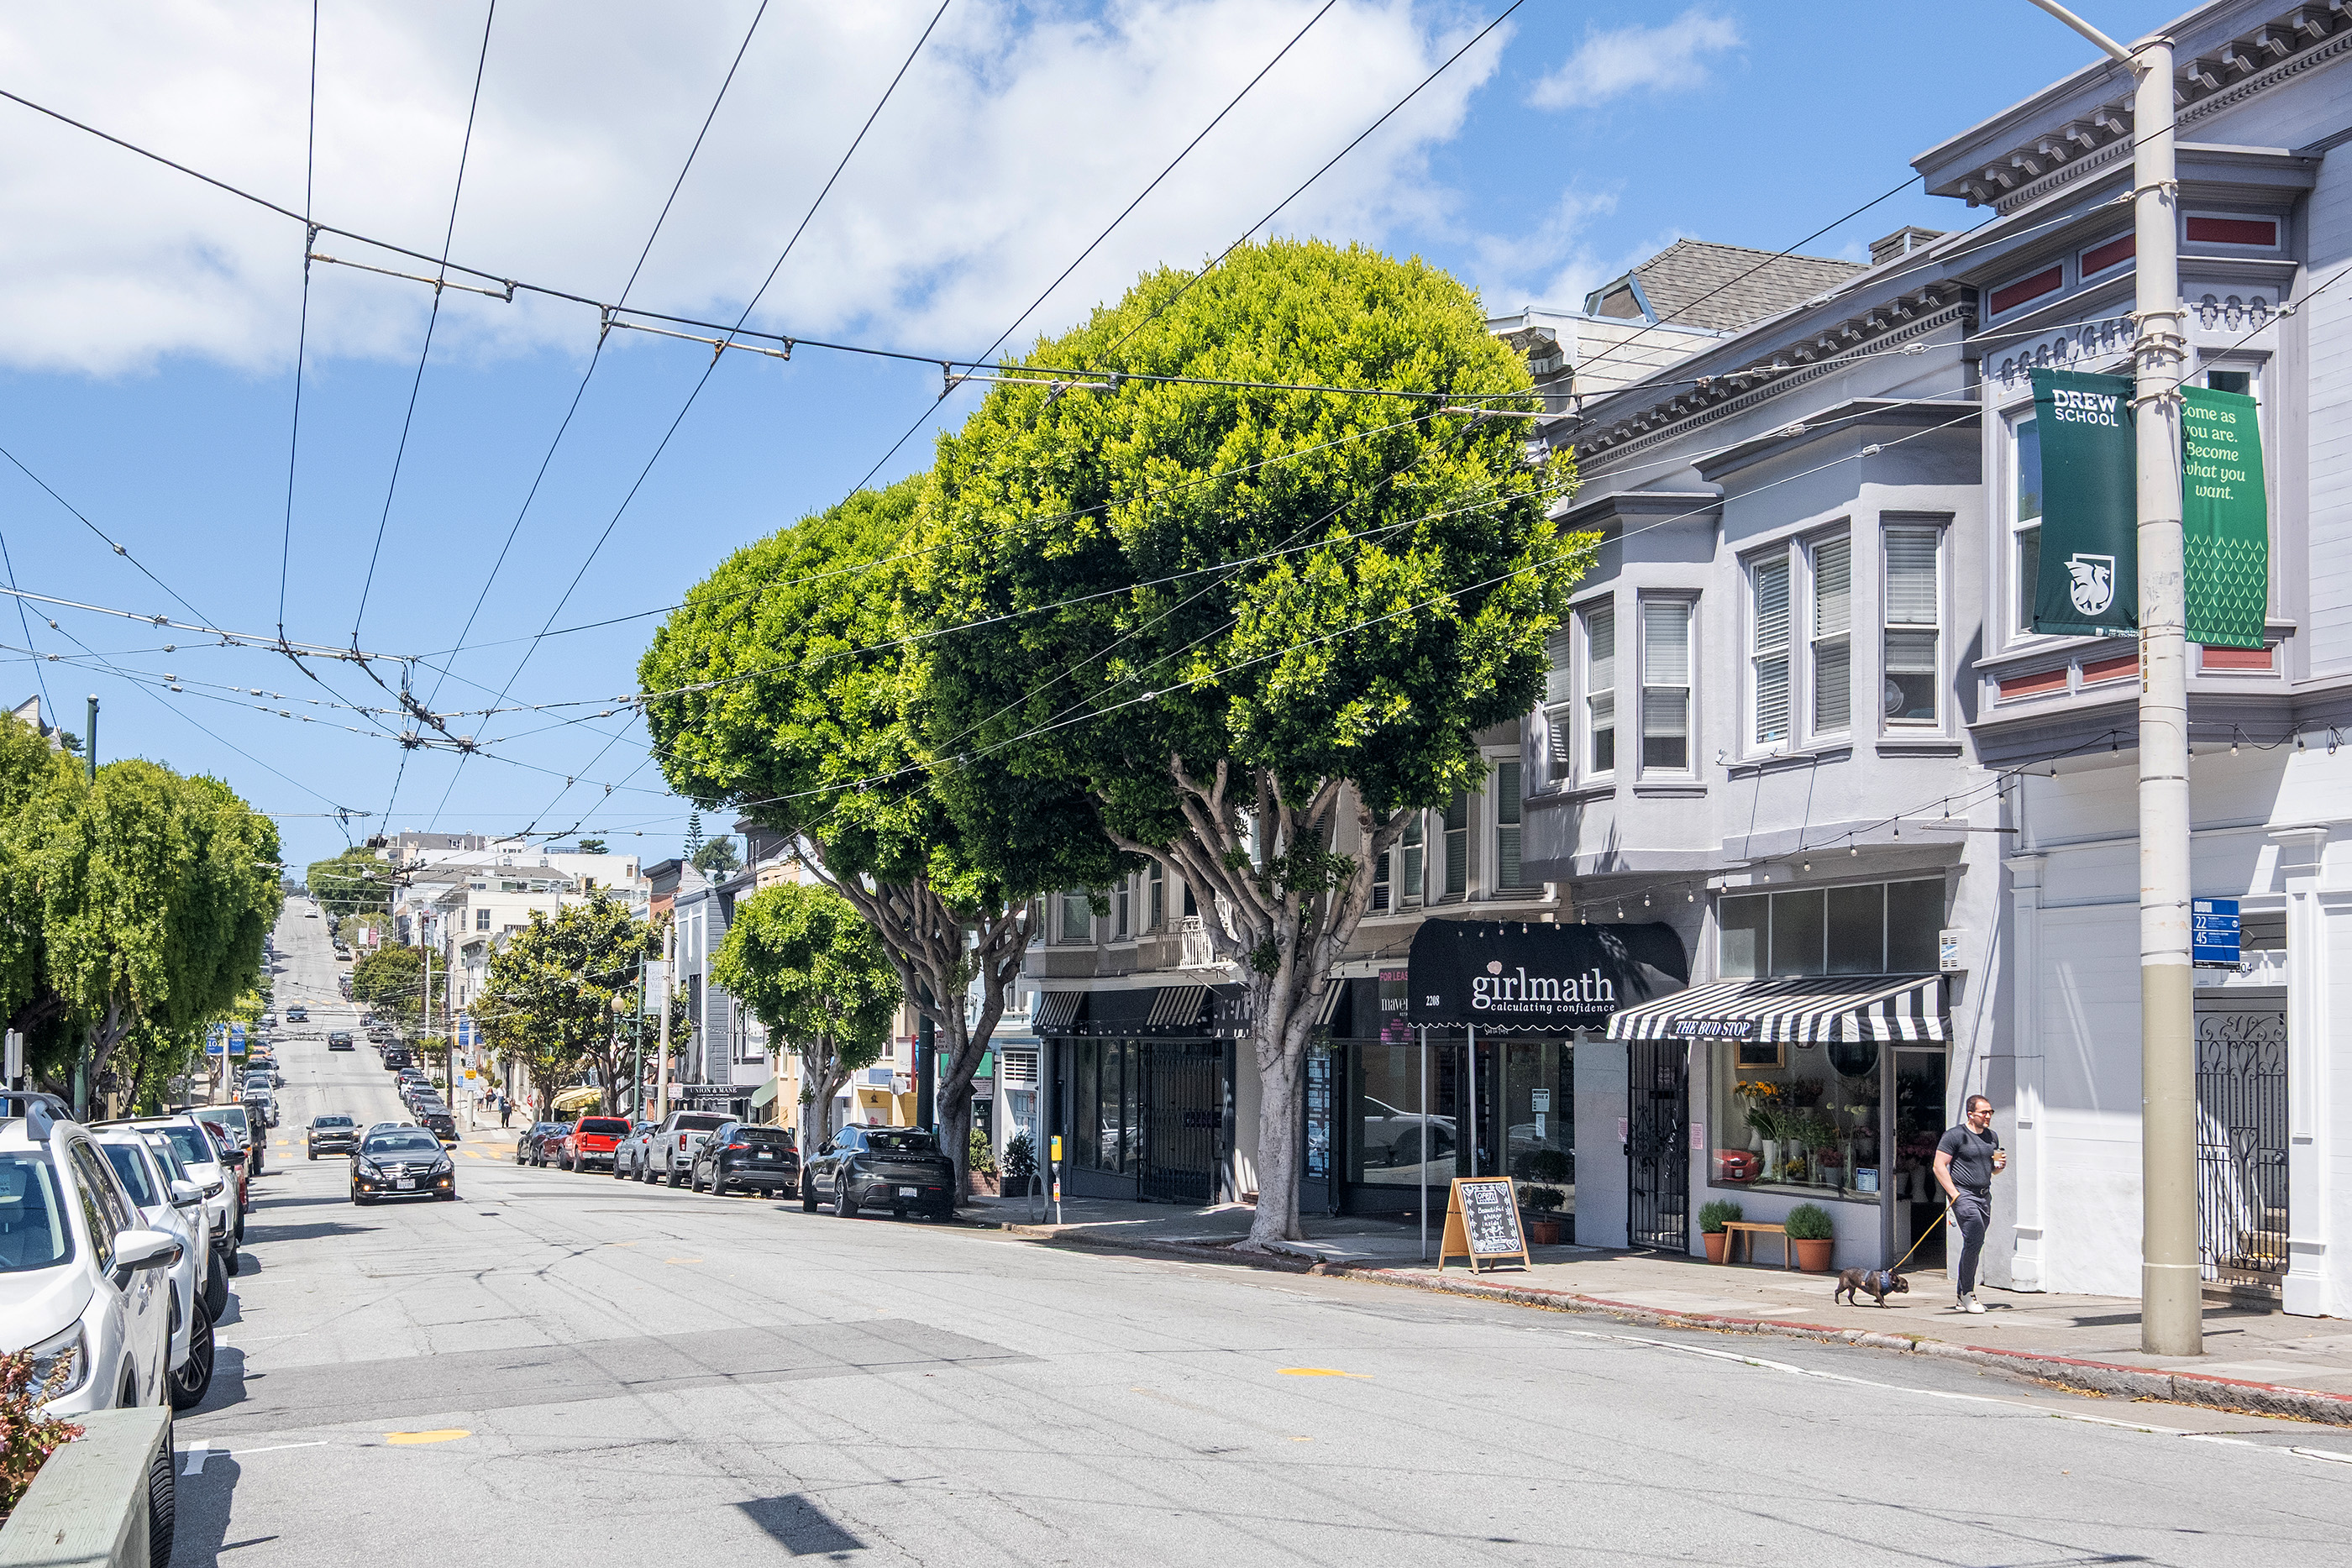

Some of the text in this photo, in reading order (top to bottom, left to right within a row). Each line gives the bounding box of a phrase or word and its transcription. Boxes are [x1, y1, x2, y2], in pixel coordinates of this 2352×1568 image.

[2052, 389, 2117, 413] DREW
[2055, 407, 2118, 427] SCHOOL
[2220, 412, 2236, 423] as
[2182, 425, 2238, 443] you are.
[2187, 442, 2239, 461] Become
[2182, 461, 2245, 483] what you
[2195, 485, 2234, 500] want.
[2196, 916, 2207, 928] 22
[2196, 931, 2207, 944] 45
[2230, 962, 2252, 973] 04
[1379, 971, 1408, 981] FOR LEAS
[1472, 964, 1614, 1009] girlmath
[1381, 998, 1408, 1010] mave
[1425, 995, 1440, 1006] 2208
[1491, 1002, 1615, 1015] calculating confidence
[1676, 1021, 1751, 1036] THE BUD STOP
